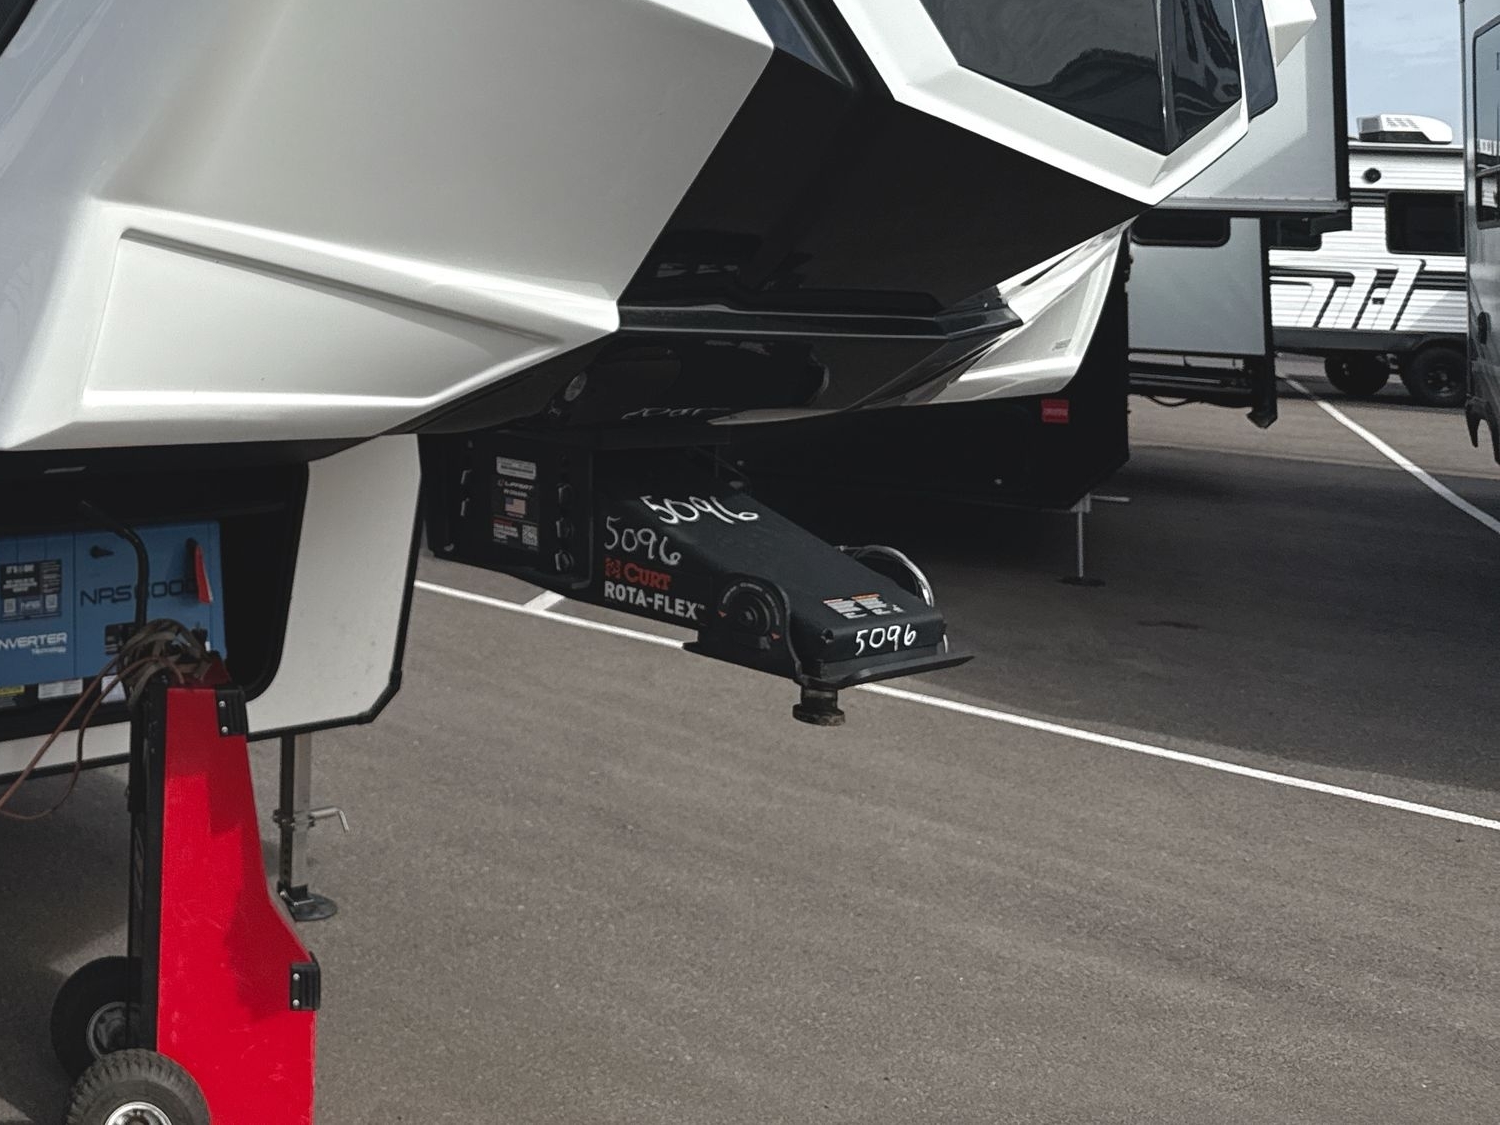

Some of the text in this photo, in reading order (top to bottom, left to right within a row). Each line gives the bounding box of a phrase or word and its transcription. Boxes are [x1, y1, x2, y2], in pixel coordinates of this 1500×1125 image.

[639, 495, 759, 525] 5096
[603, 515, 682, 566] 5096
[623, 562, 672, 591] CURT
[855, 623, 917, 656] 5096
